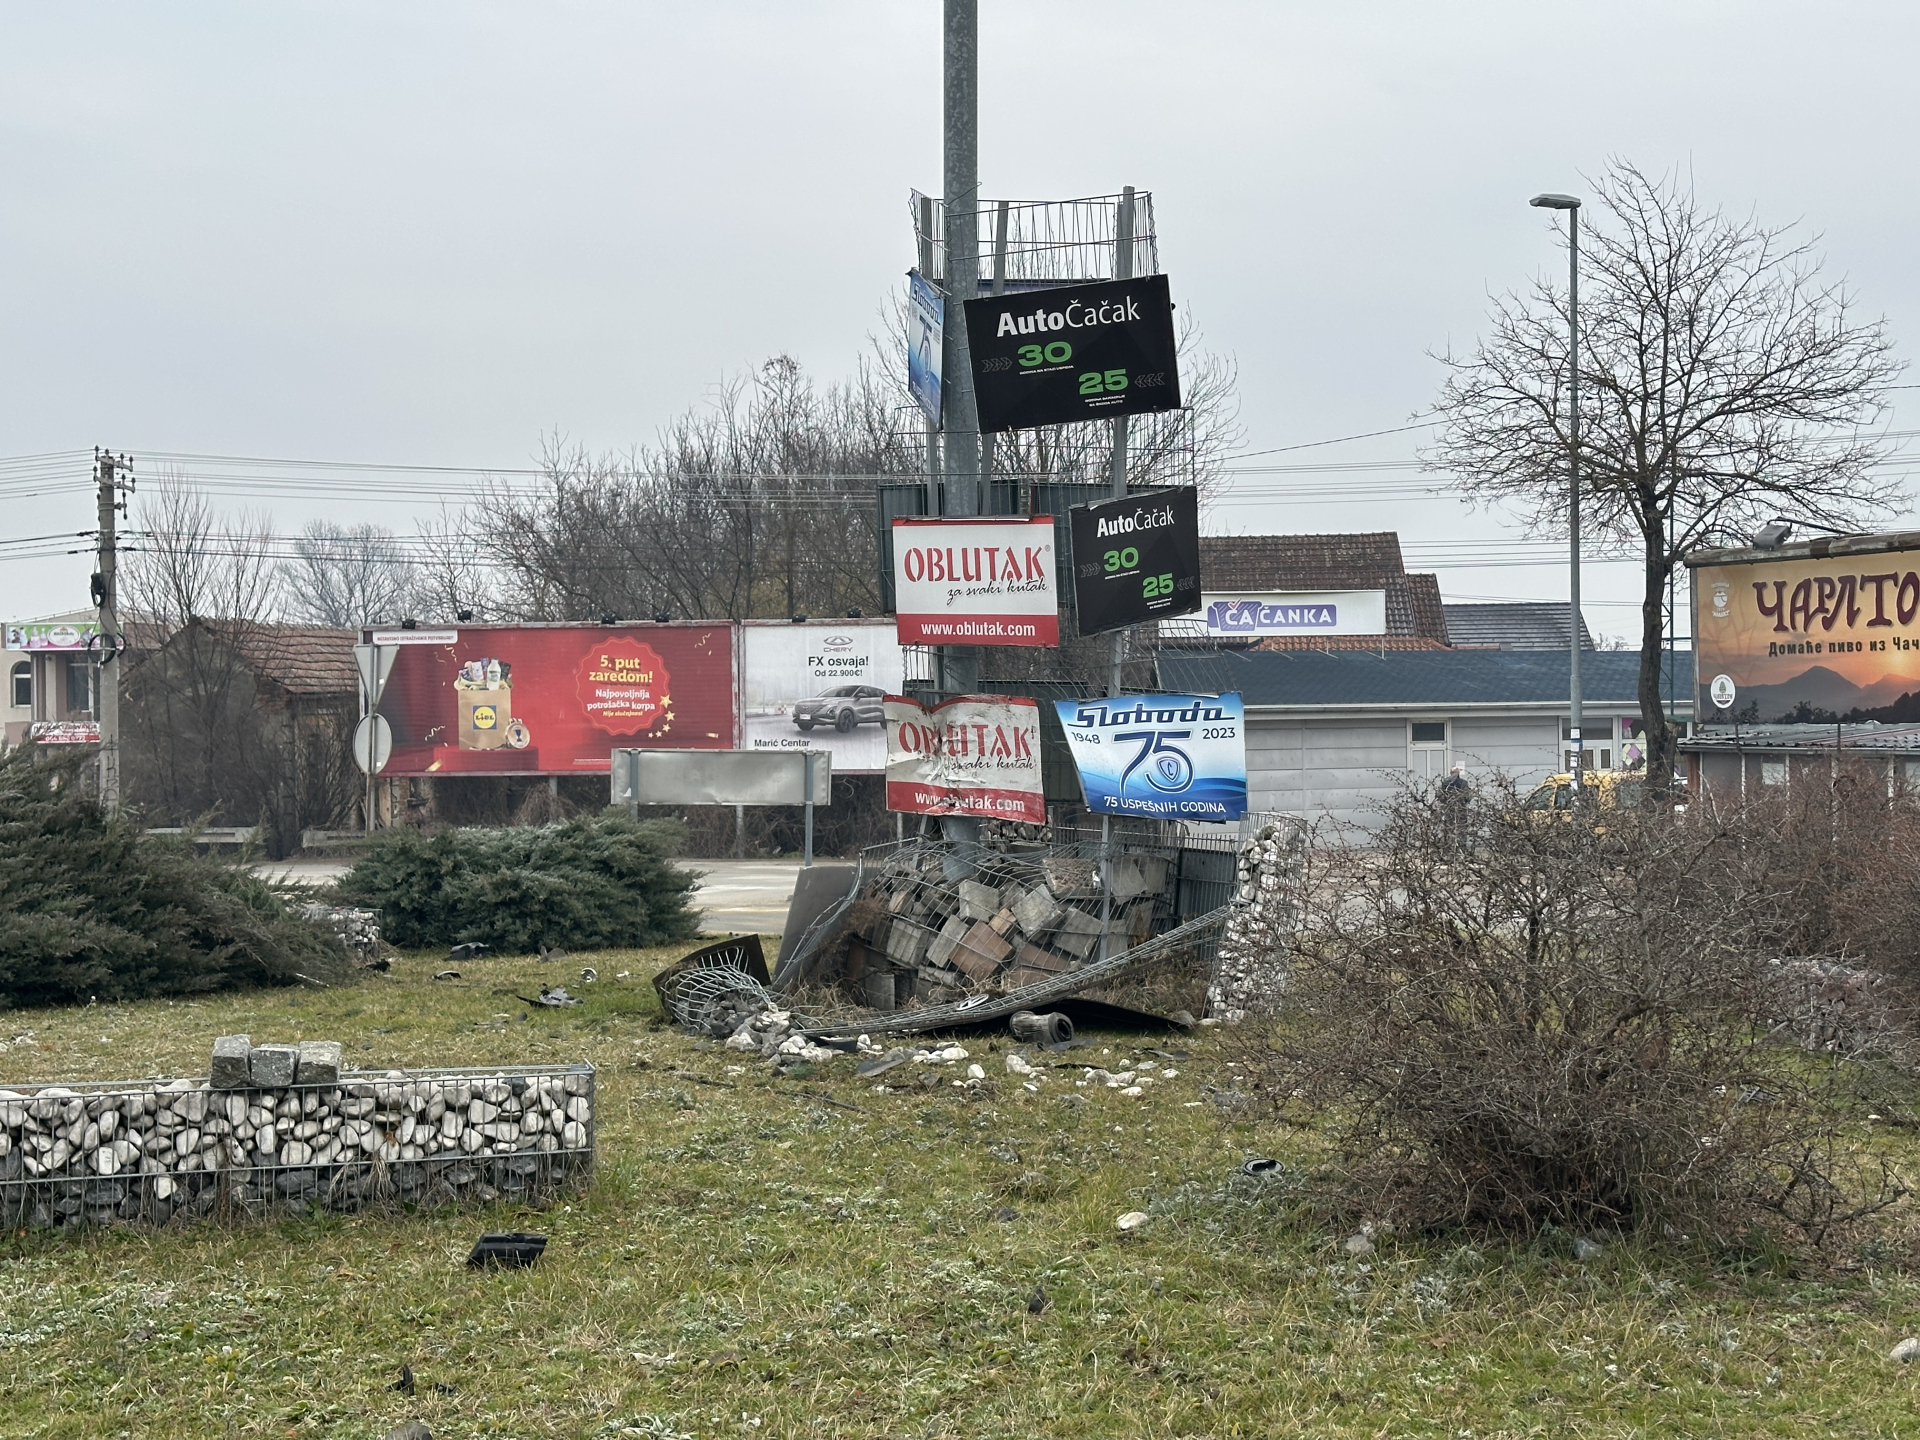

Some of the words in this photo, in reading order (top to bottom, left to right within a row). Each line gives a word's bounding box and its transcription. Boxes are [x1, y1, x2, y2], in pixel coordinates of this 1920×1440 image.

[996, 296, 1141, 338] AutoČačak
[1017, 341, 1073, 367] 30
[1078, 368, 1129, 395] 25
[1096, 504, 1175, 538] AutoČačak
[904, 546, 1046, 582] OBLUTAK
[1103, 546, 1139, 572] 30
[946, 587, 962, 606] za
[966, 580, 1002, 596] svaki
[1006, 575, 1048, 593] kutak
[1142, 572, 1175, 598] 25
[1225, 600, 1333, 625] ČAČANKA
[920, 621, 1036, 637] www.oblutak.com
[1768, 640, 1822, 657] Домаће
[1828, 641, 1863, 653] пиво
[1869, 639, 1886, 651] из
[600, 654, 612, 668] 5.
[614, 657, 640, 671] put
[808, 656, 824, 667] FX
[827, 655, 869, 668] osvaja!
[588, 669, 653, 683] zaredom!
[814, 669, 826, 677] Od
[828, 669, 863, 677] 22.900€!
[595, 688, 650, 700] Najpovoljnija
[586, 699, 630, 711] potrošačka
[631, 700, 656, 711] korpa
[1068, 701, 1235, 727] Sloboda
[754, 738, 778, 747] Marić
[780, 738, 811, 747] Centar
[996, 755, 1035, 770] kutak
[1071, 731, 1101, 744] 1948
[1113, 730, 1194, 797] 75
[1202, 727, 1236, 740] 2023
[1103, 796, 1118, 808] 75
[1120, 797, 1178, 812] USPEŠNIH
[1180, 801, 1226, 813] GODINA
